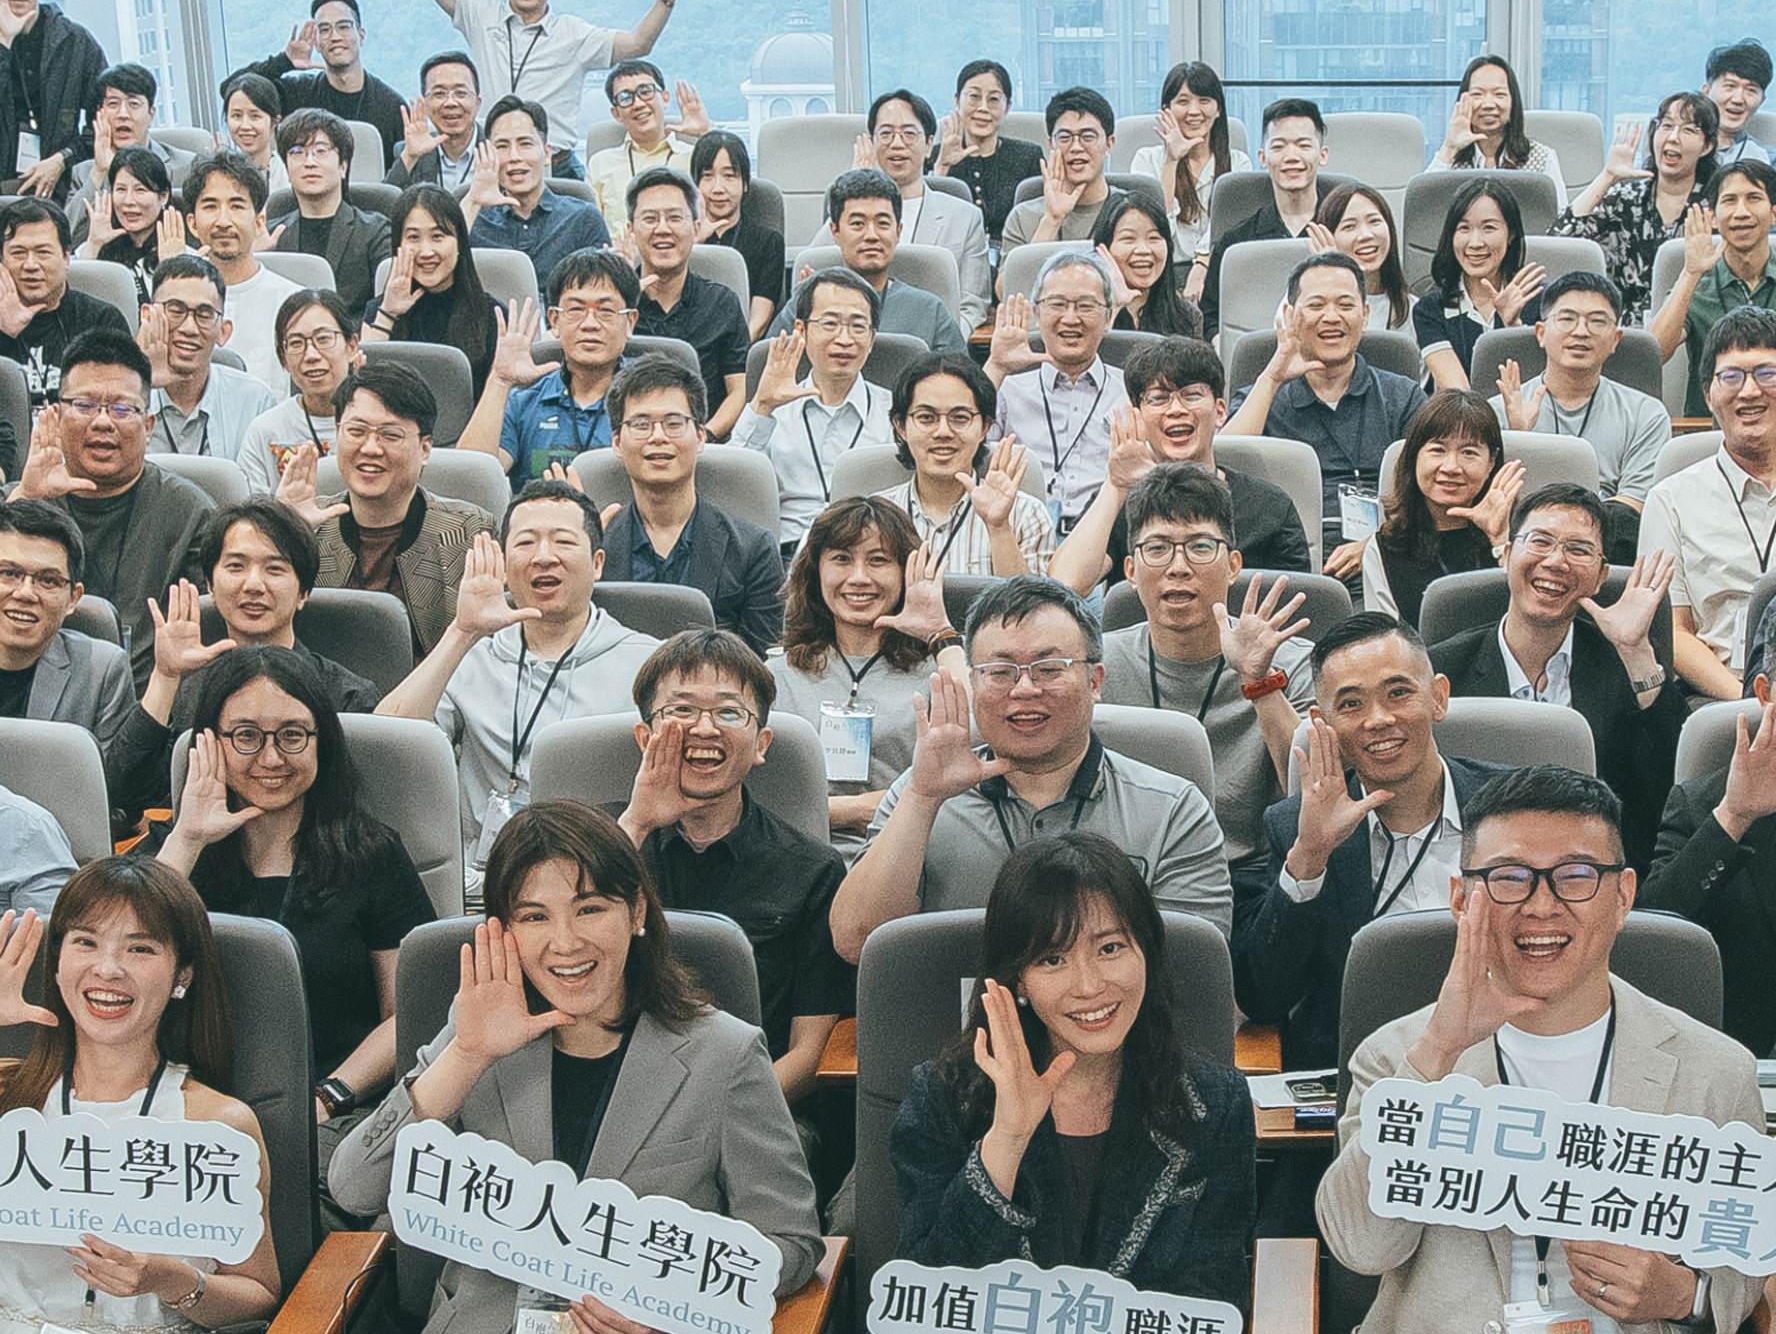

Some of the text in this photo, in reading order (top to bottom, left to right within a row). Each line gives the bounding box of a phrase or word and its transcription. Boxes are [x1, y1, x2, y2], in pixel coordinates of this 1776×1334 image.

[50, 1206, 104, 1233] Life
[111, 1211, 245, 1247] Academy
[403, 1207, 484, 1253] White
[491, 1240, 554, 1278] Coat
[560, 1262, 614, 1297] Life
[405, 1142, 761, 1309] 白袍人生學院
